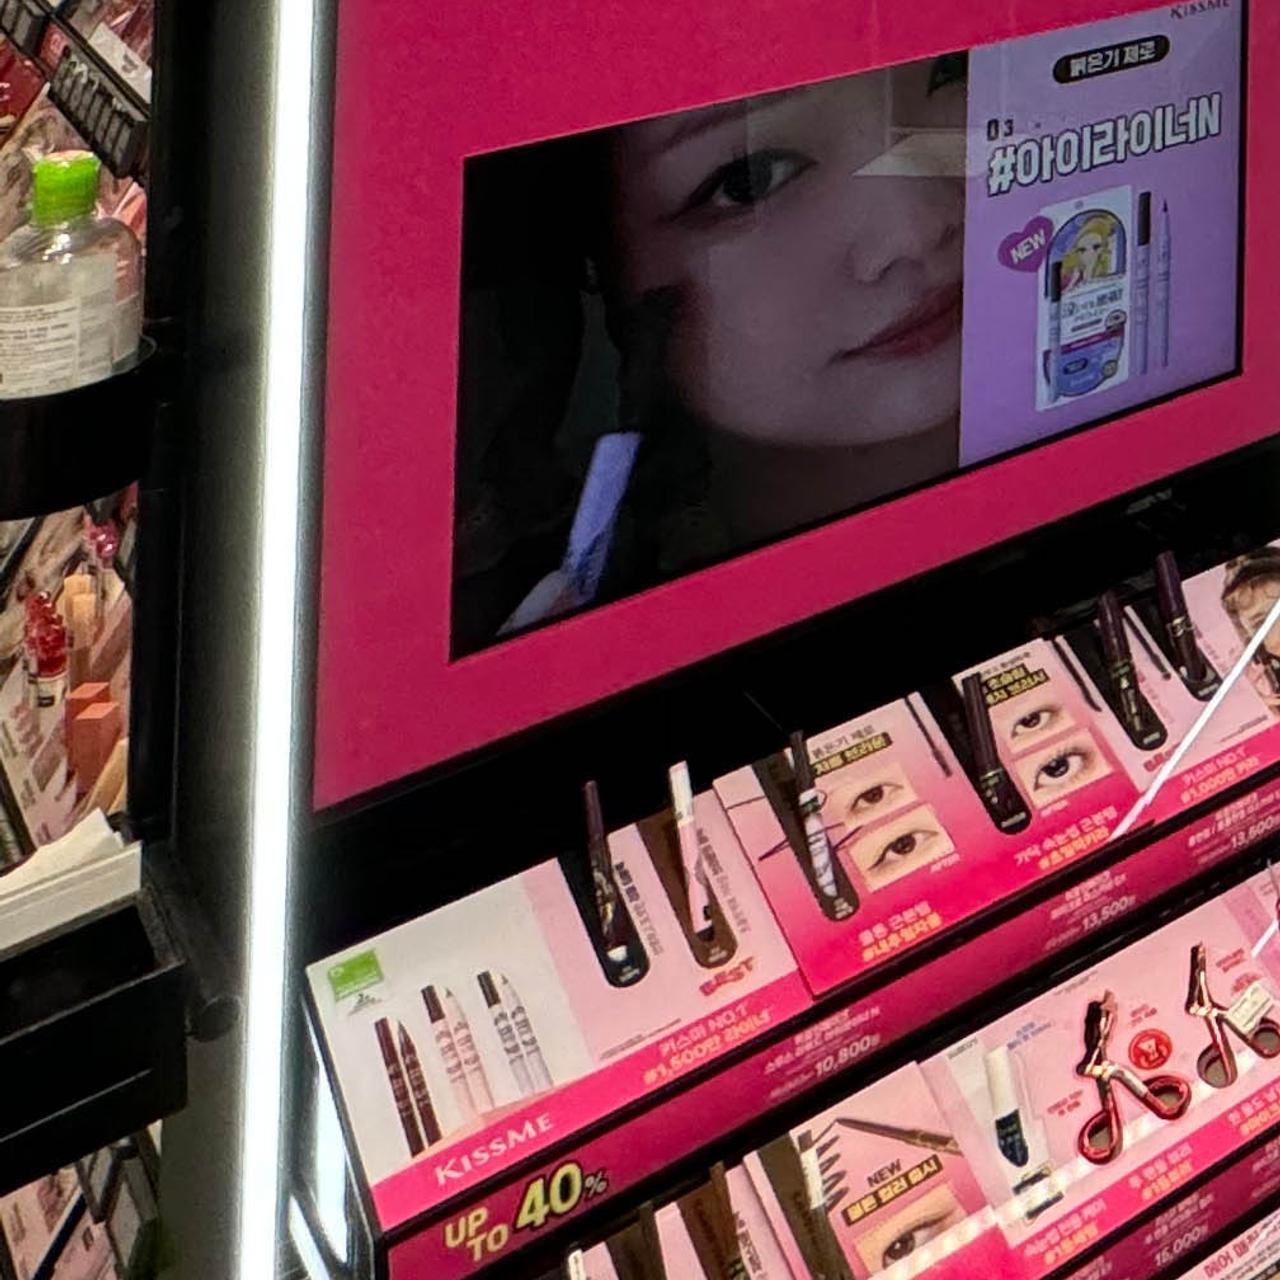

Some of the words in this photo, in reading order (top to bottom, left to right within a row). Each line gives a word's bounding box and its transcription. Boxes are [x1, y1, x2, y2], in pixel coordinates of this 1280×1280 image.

[1010, 230, 1046, 264] NEW
[434, 1113, 554, 1186] KISSME
[866, 1158, 902, 1188] NEW
[515, 1162, 609, 1230] 40%
[444, 1207, 488, 1248] UP
[466, 1223, 508, 1262] TO
